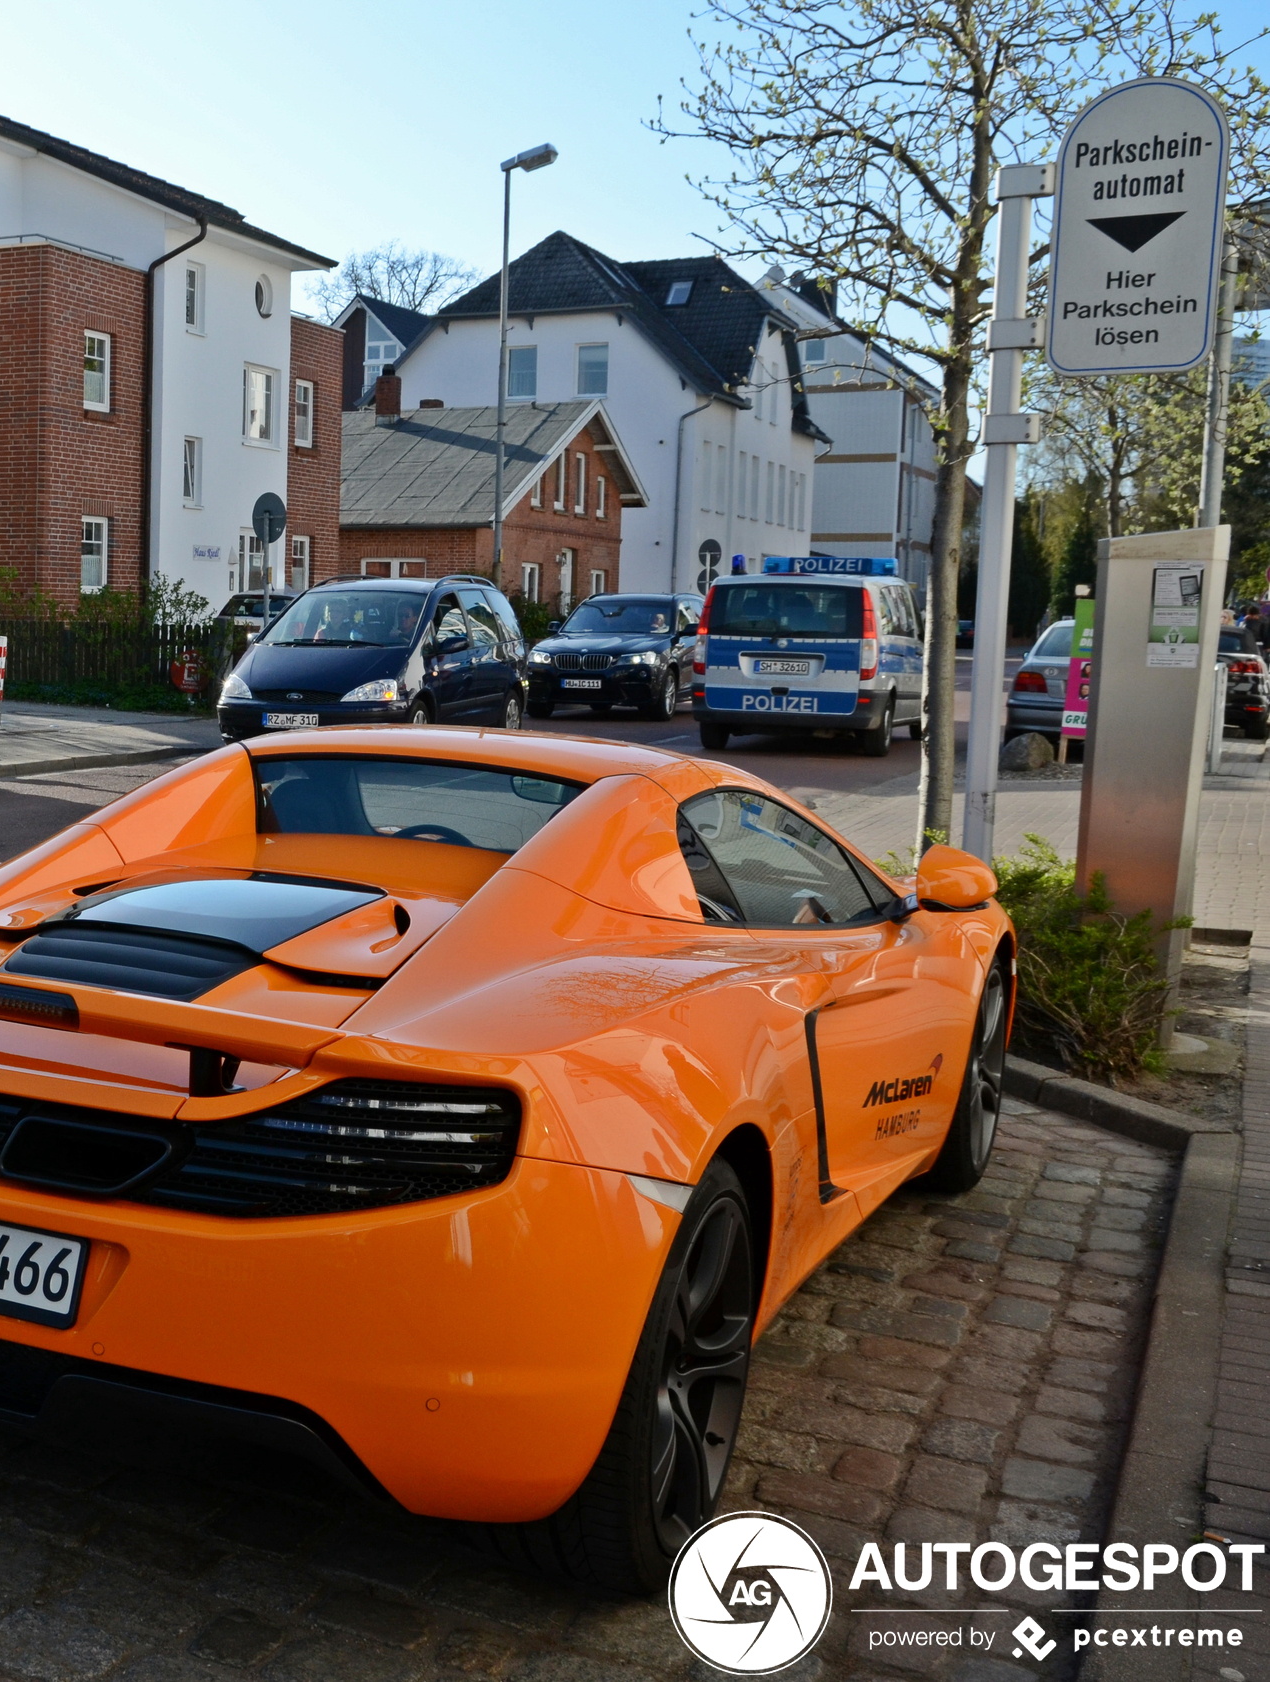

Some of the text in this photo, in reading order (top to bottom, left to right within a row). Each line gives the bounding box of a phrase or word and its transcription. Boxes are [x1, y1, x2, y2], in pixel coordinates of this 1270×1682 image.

[1075, 132, 1212, 168] Parkschein-
[1093, 168, 1185, 200] automat
[1106, 270, 1156, 289] Hier
[1063, 295, 1197, 319] Parkschein
[1095, 327, 1159, 346] lösen
[794, 559, 862, 572] POLIZEI
[760, 662, 808, 673] SH 32610
[742, 695, 818, 712] POLIZEI
[267, 715, 318, 725] RZ MF 310
[862, 1075, 932, 1108] McLaren
[874, 1109, 921, 1141] HAMBURG
